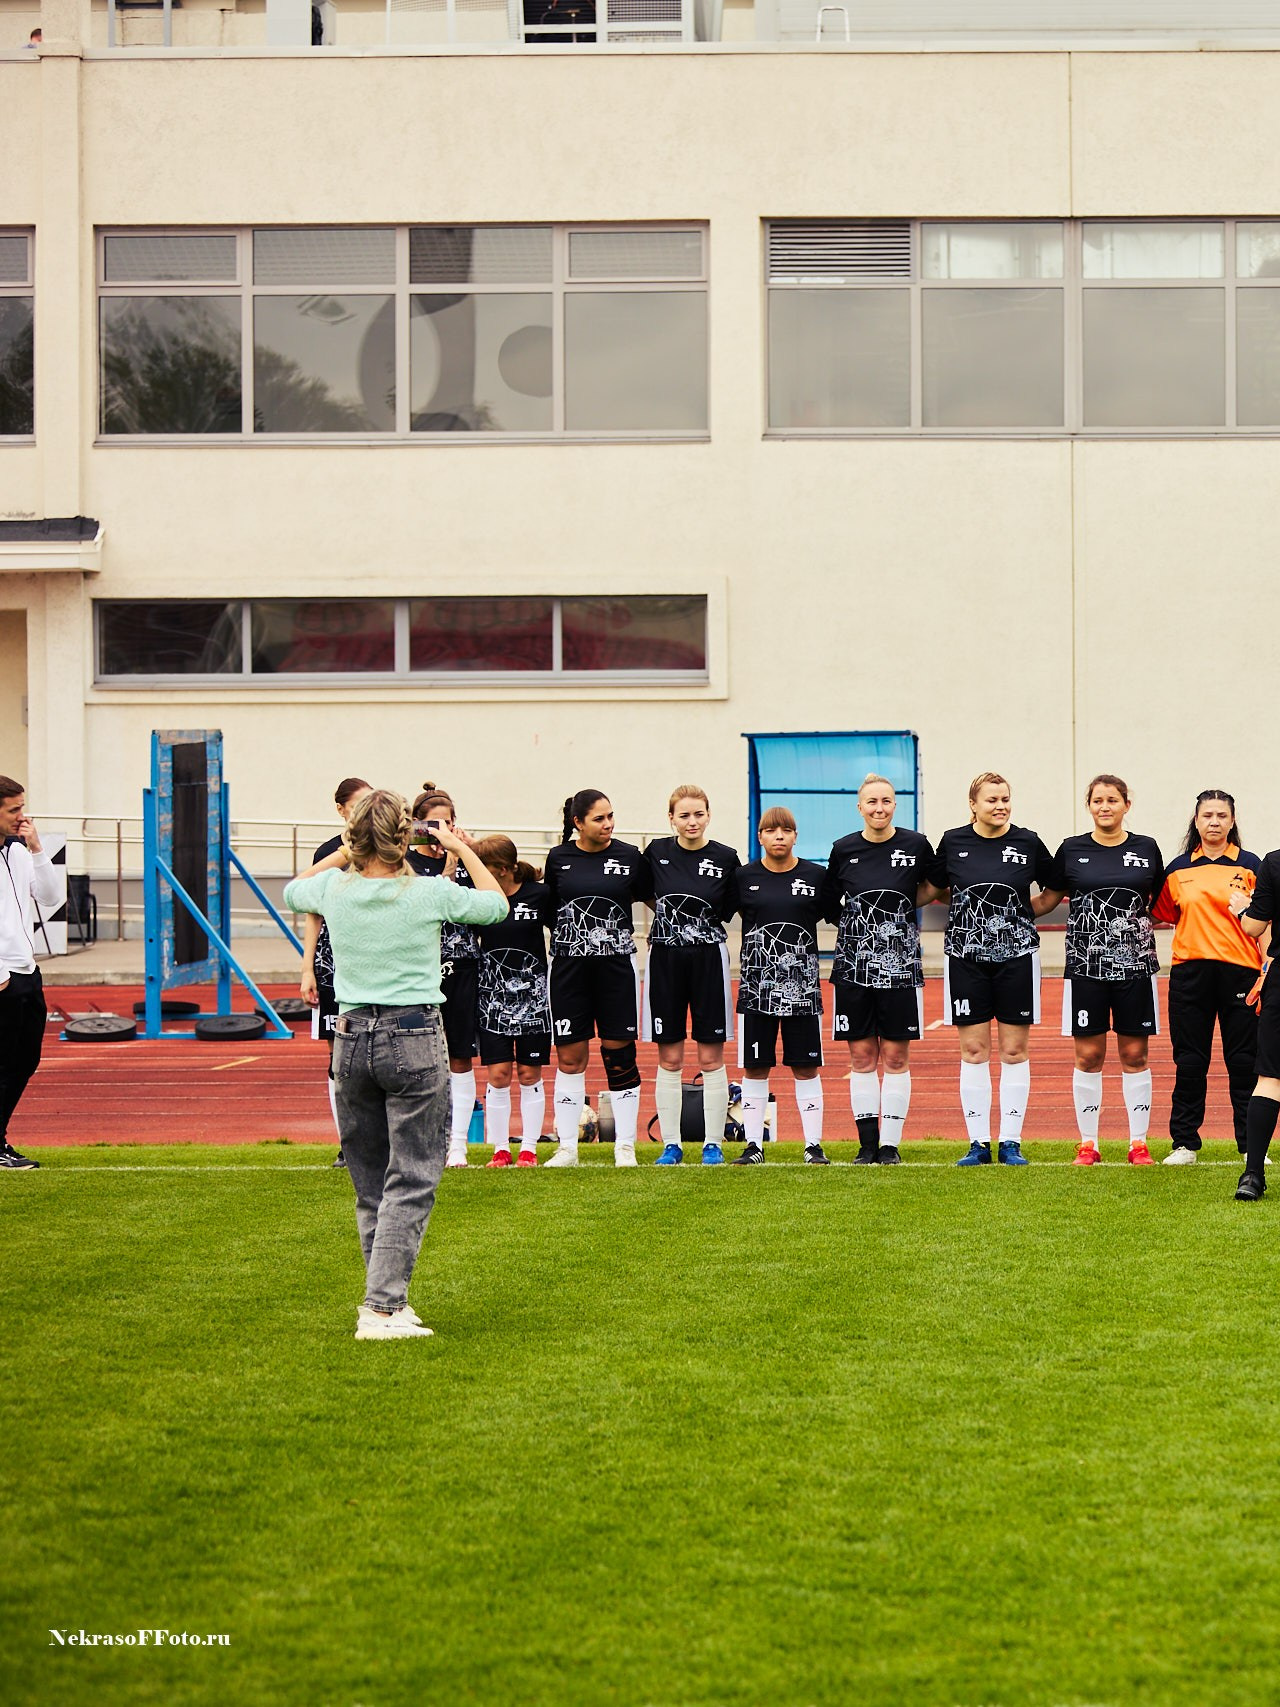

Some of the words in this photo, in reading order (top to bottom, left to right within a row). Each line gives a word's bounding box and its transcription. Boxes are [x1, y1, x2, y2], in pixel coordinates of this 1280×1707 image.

[891, 859, 916, 867] ГАЗ
[1003, 856, 1027, 865] ГАЗ
[1123, 860, 1149, 869] ГАЗ
[603, 867, 630, 876] ГАЗ
[698, 867, 723, 879] ГАЗ
[791, 888, 816, 897] ГАЗ
[514, 911, 538, 921] ГАЗ
[954, 999, 971, 1017] 14
[835, 1014, 850, 1032] 13
[1077, 1009, 1089, 1028] 8
[554, 1018, 572, 1037] 12
[653, 1017, 663, 1035] 6
[751, 1041, 760, 1059] 1
